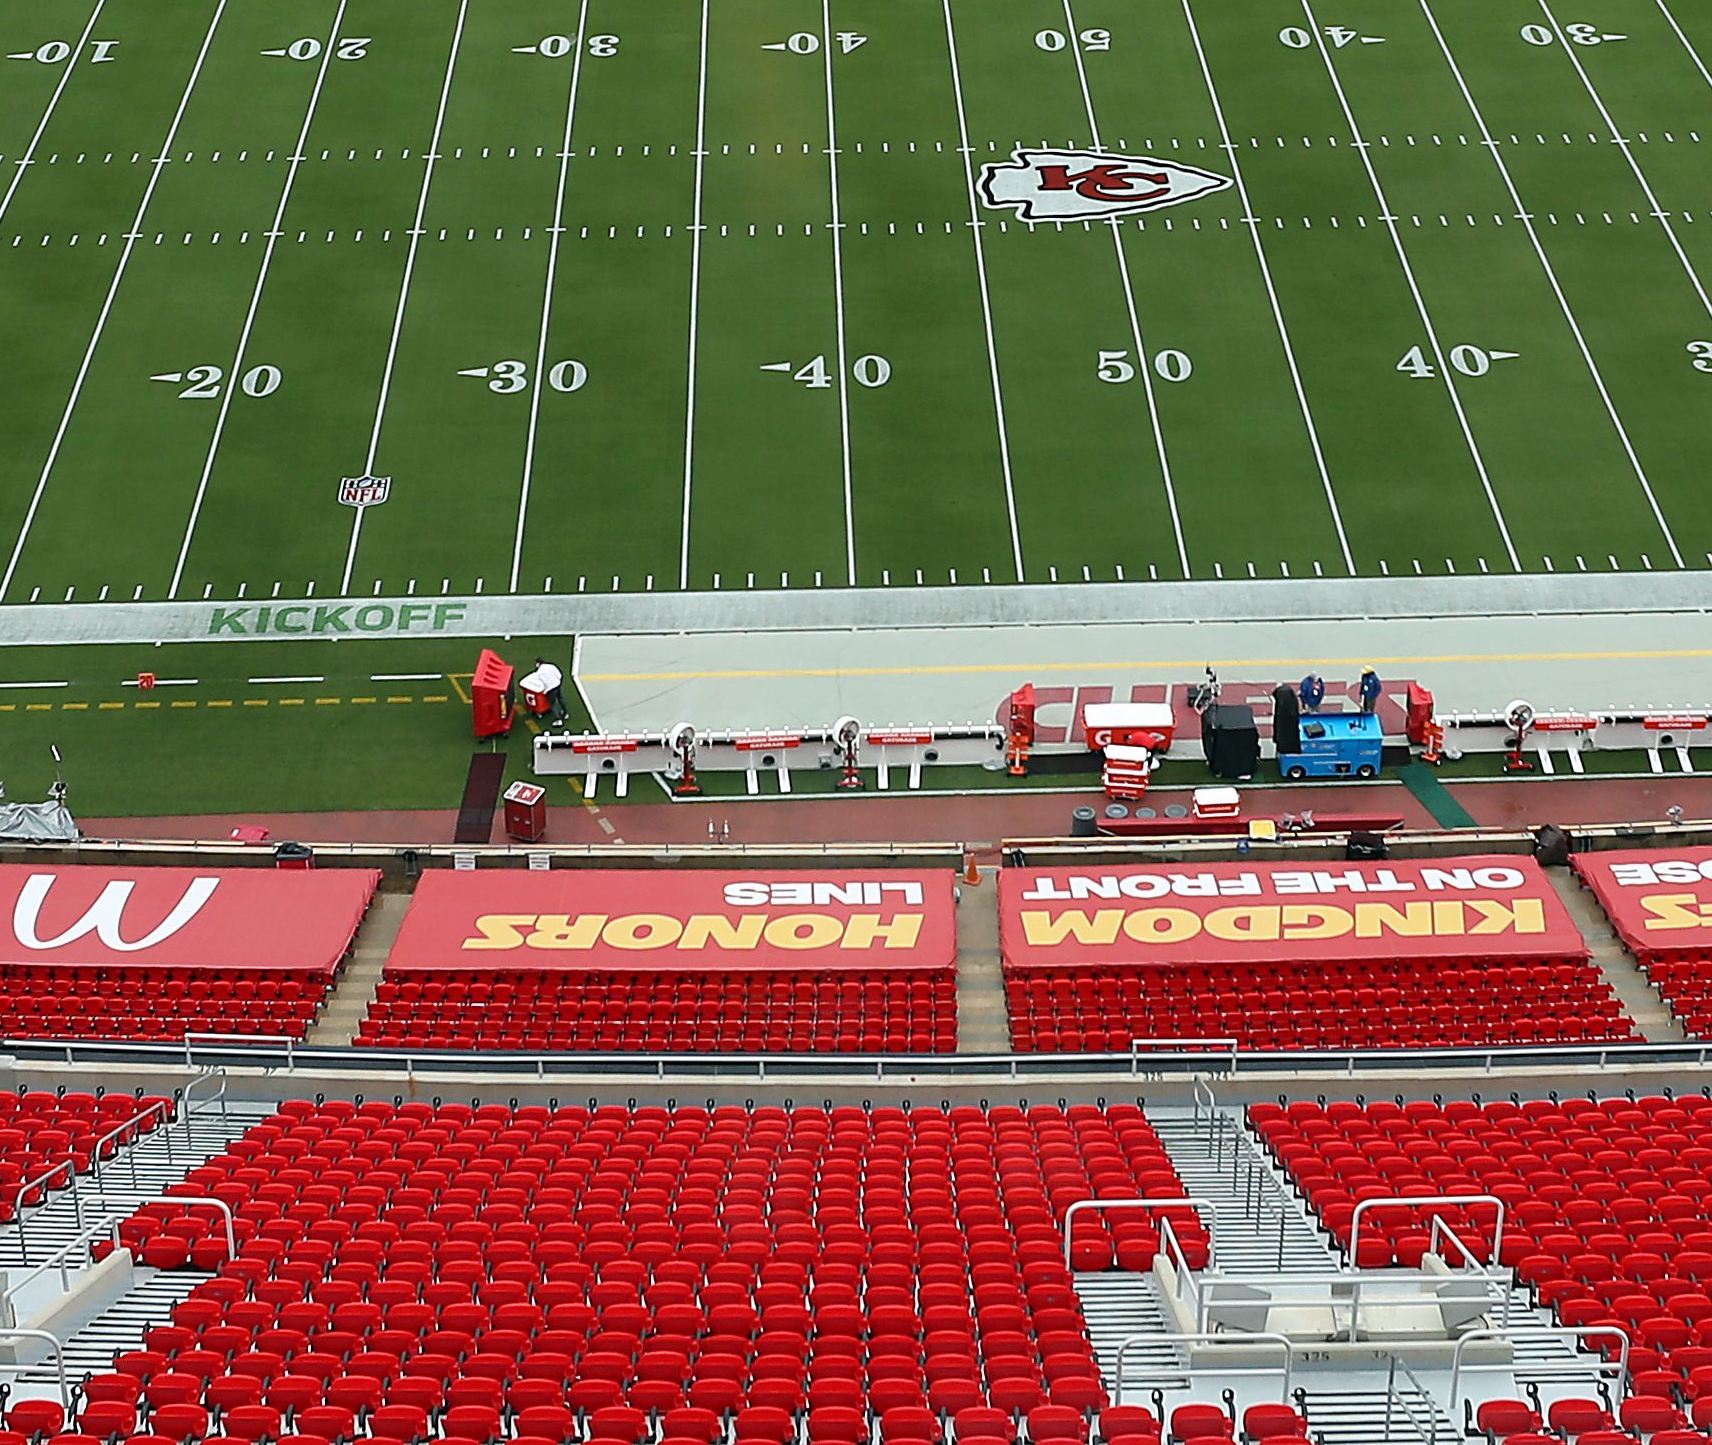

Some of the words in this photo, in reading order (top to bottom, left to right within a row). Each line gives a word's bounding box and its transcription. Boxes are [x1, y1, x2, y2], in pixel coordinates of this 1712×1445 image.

[488, 360, 588, 393] 30
[793, 355, 891, 388] 40
[1096, 350, 1192, 383] 50
[1395, 344, 1490, 378] 40
[178, 364, 282, 398] 20
[341, 486, 388, 506] NFL
[208, 603, 468, 635] KICKOFF
[724, 880, 925, 906] LINES
[1022, 872, 1263, 900] FRONT
[1271, 869, 1416, 895] THE
[1420, 867, 1525, 892] ON
[461, 912, 924, 950] HONORS
[1020, 896, 1547, 947] KINGDOM
